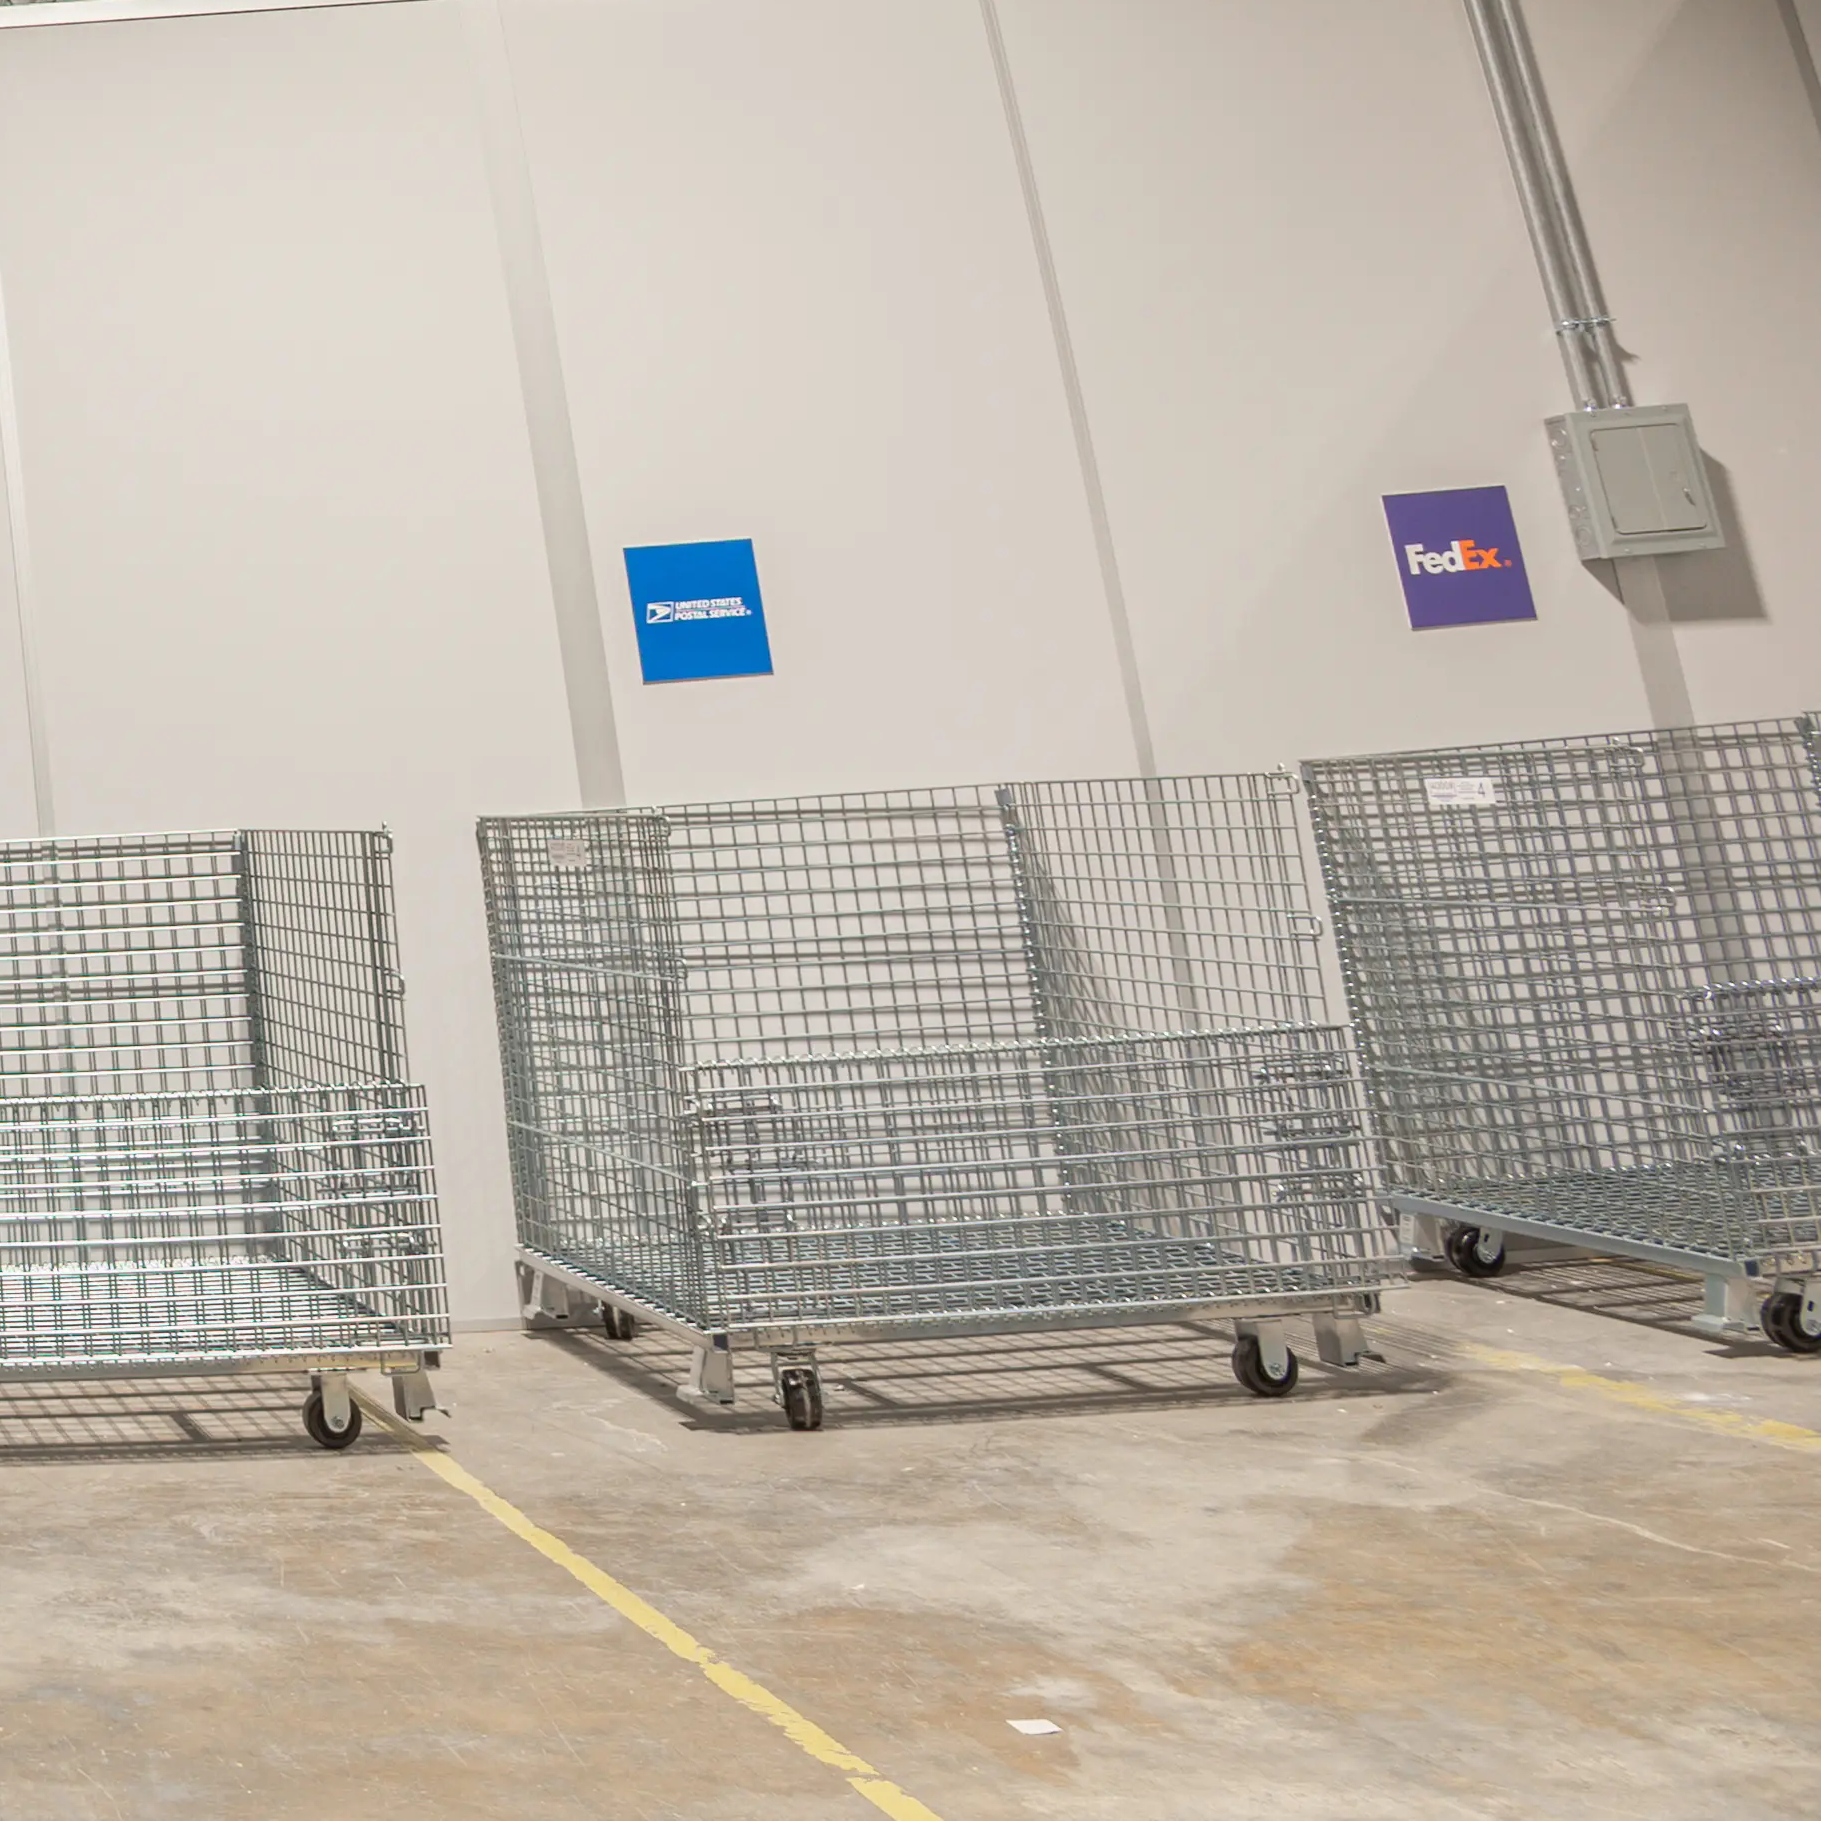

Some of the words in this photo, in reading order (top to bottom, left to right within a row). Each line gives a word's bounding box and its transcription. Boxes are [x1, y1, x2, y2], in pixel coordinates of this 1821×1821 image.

[1404, 539, 1503, 576] FedEx
[676, 600, 709, 610] UNITED
[710, 597, 743, 607] STATES
[675, 610, 709, 620] POSTAL
[709, 607, 746, 618] SERVICE
